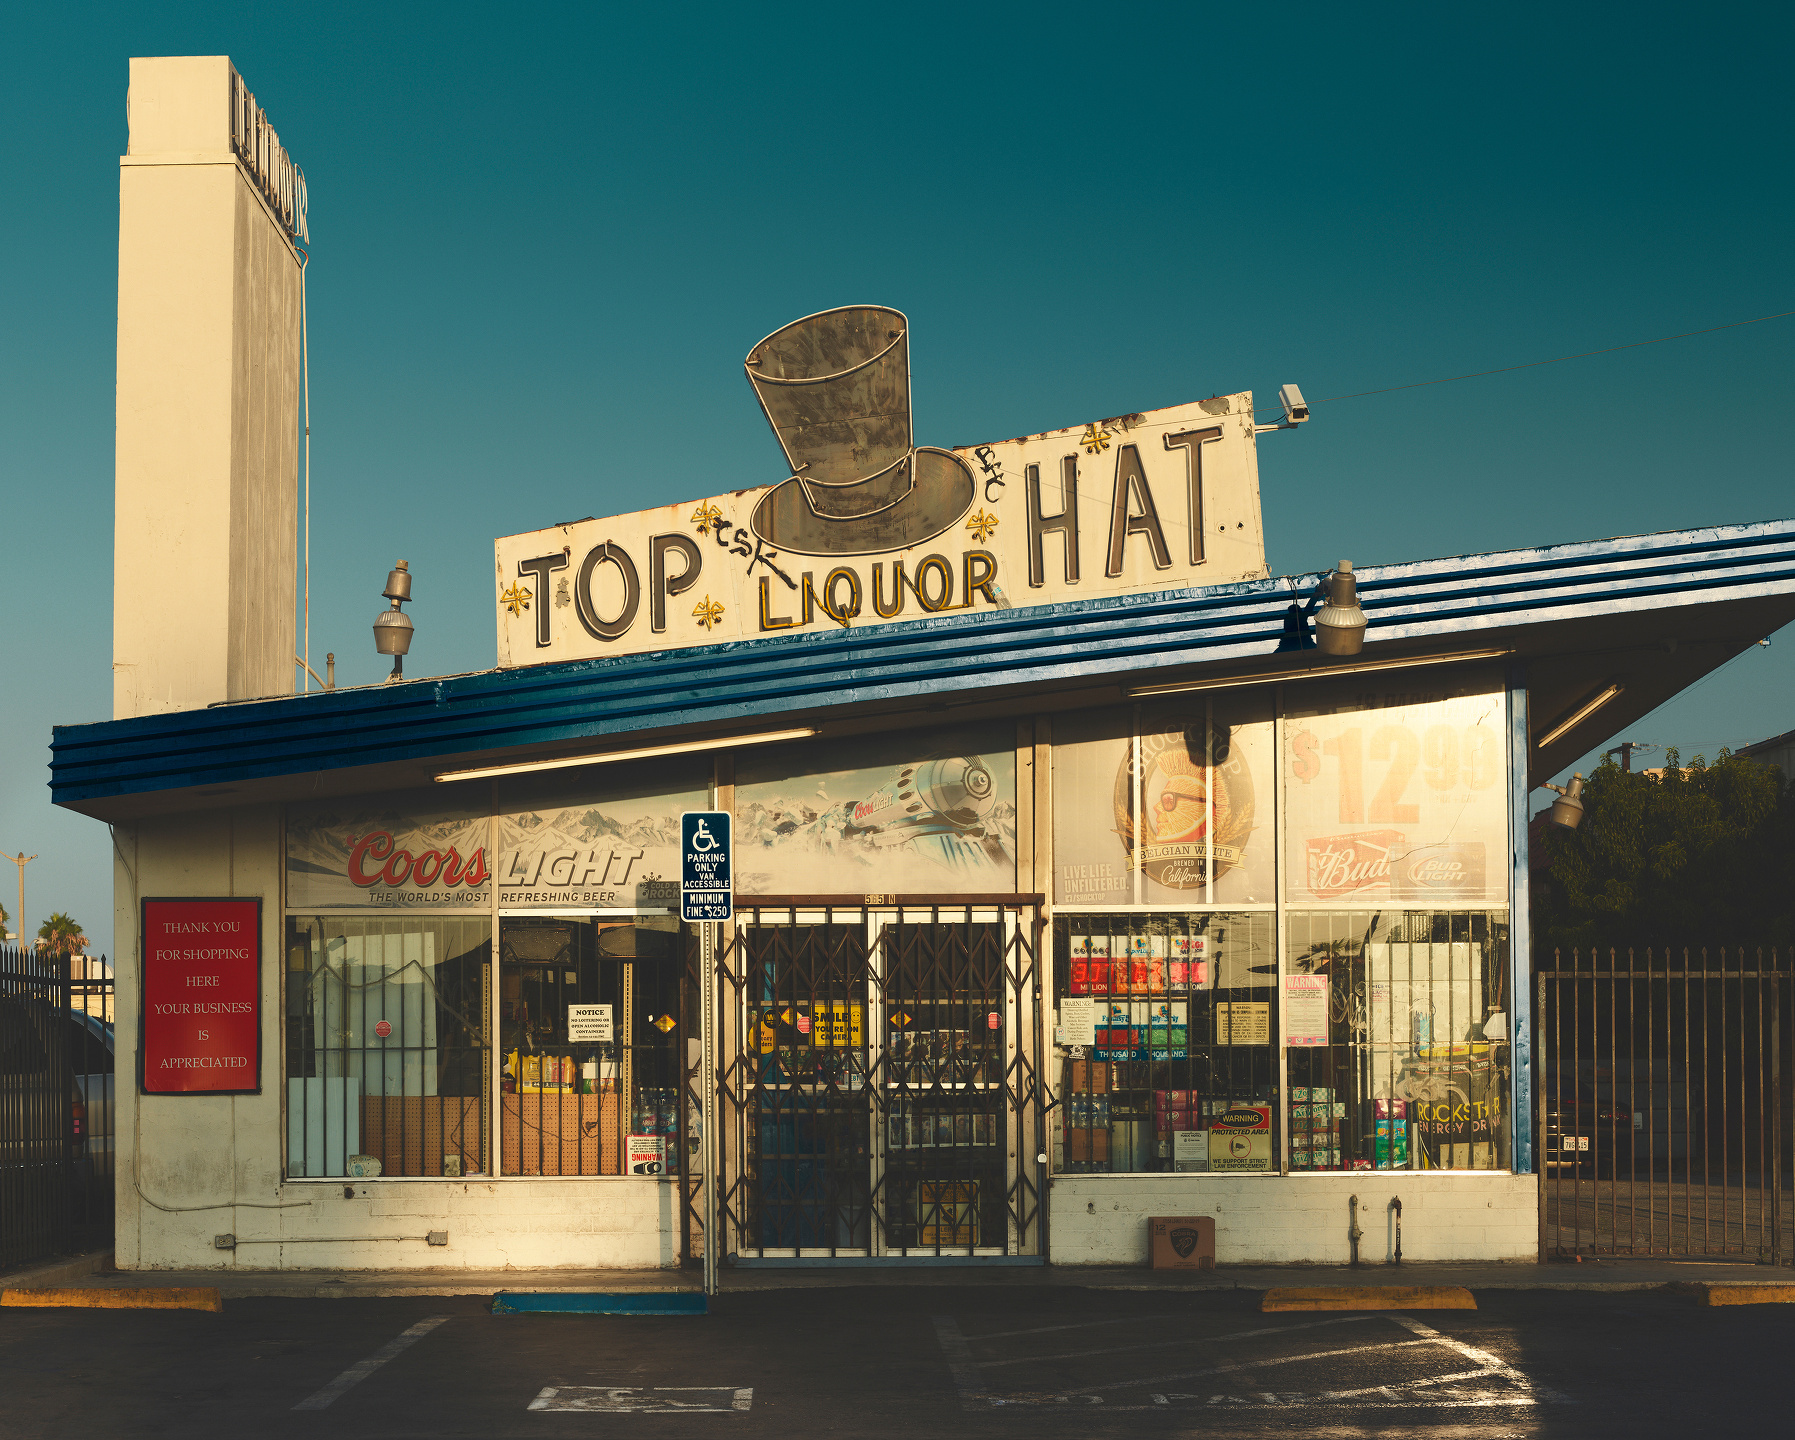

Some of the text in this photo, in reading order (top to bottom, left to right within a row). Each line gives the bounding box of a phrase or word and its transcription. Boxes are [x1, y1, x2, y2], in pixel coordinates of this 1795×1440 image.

[518, 422, 1226, 649] TOP HAT
[758, 550, 998, 632] LIQUOR
[687, 853, 726, 863] PARKING
[1140, 846, 1191, 860] BELGIAN
[1195, 846, 1233, 859] WITE
[346, 831, 645, 888] Coors LIGHT
[1425, 860, 1463, 871] BUD
[694, 863, 718, 872] ONLY
[1063, 864, 1112, 879] LIVE LIFE
[699, 872, 715, 880] VAN
[1161, 865, 1209, 889] California
[1416, 871, 1467, 881] LIGHT
[684, 880, 730, 888] ACCESSIBLE
[1064, 876, 1130, 893] UNFILTERED.
[369, 891, 616, 903] THE WORLD'S MOST REFRESHING BEER
[649, 889, 681, 899] ROCK
[689, 893, 724, 904] MINIMUM
[889, 894, 896, 904] N
[686, 905, 727, 918] FINE $250
[163, 921, 241, 934] THANK YOU
[156, 948, 249, 961] FOR SHOPPING
[186, 976, 220, 987] HERE
[1287, 977, 1326, 989] WARNING
[154, 1002, 252, 1015] YOUR BUSINESS
[815, 1012, 849, 1022] SMILE
[197, 1030, 209, 1041] IS
[160, 1056, 248, 1069] APPRECIATED
[632, 1153, 663, 1162] WARNING
